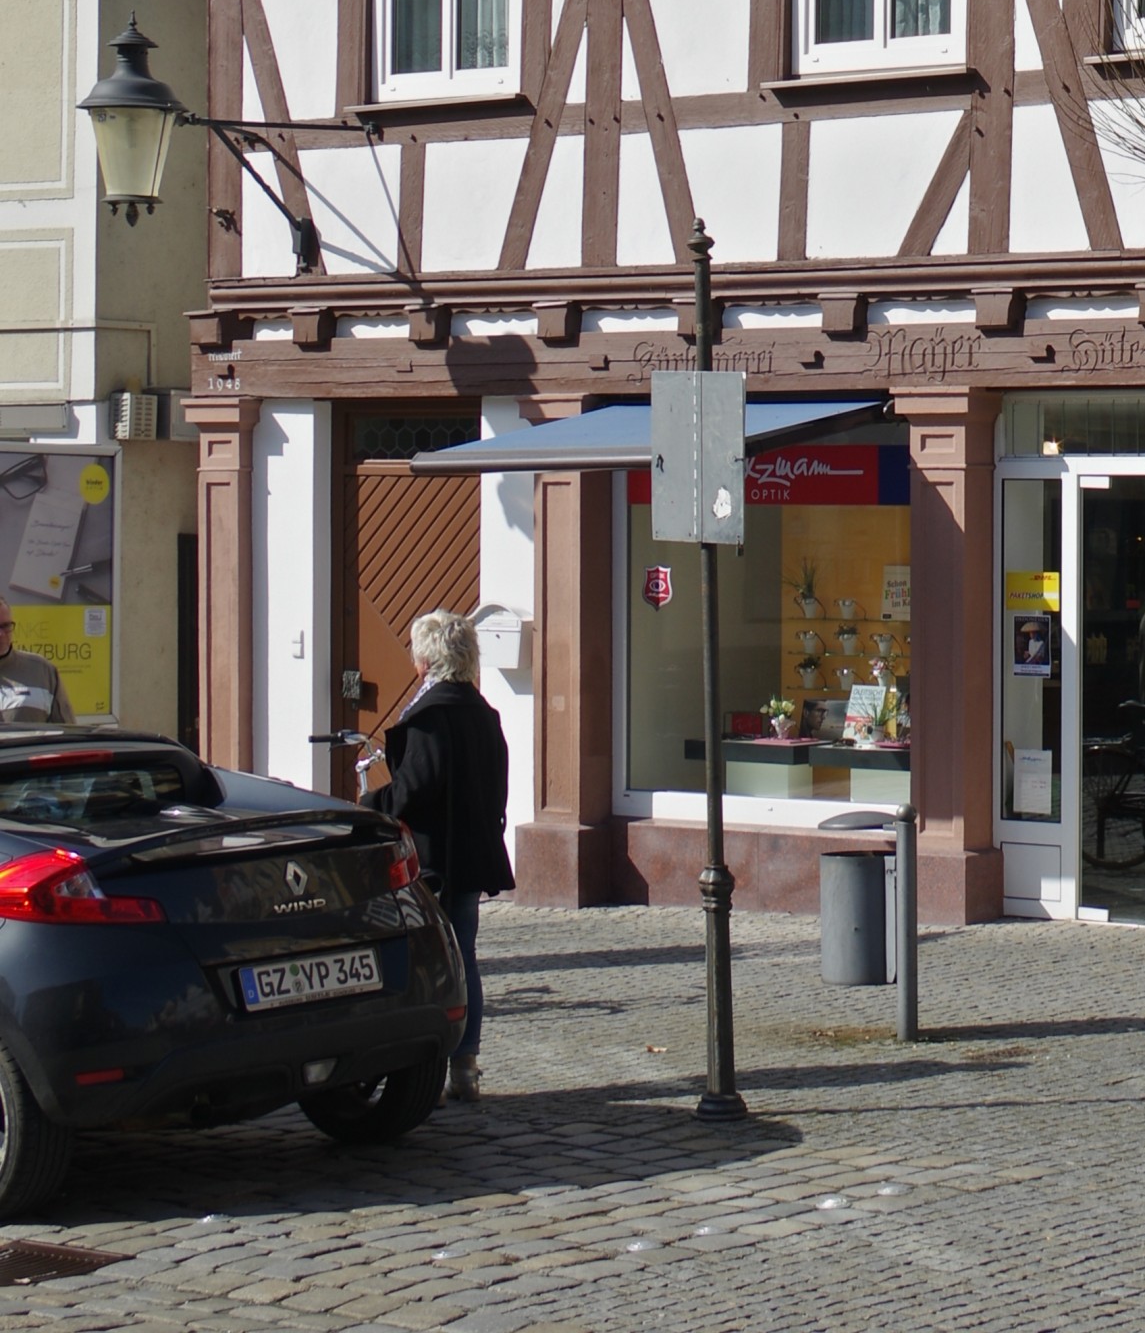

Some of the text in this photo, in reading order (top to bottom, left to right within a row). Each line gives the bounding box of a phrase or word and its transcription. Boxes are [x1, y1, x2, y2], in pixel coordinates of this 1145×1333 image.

[751, 489, 790, 500] OPTIK
[274, 899, 326, 913] WIND
[257, 967, 291, 998] GZ
[301, 961, 330, 990] YP
[333, 954, 375, 985] 345
